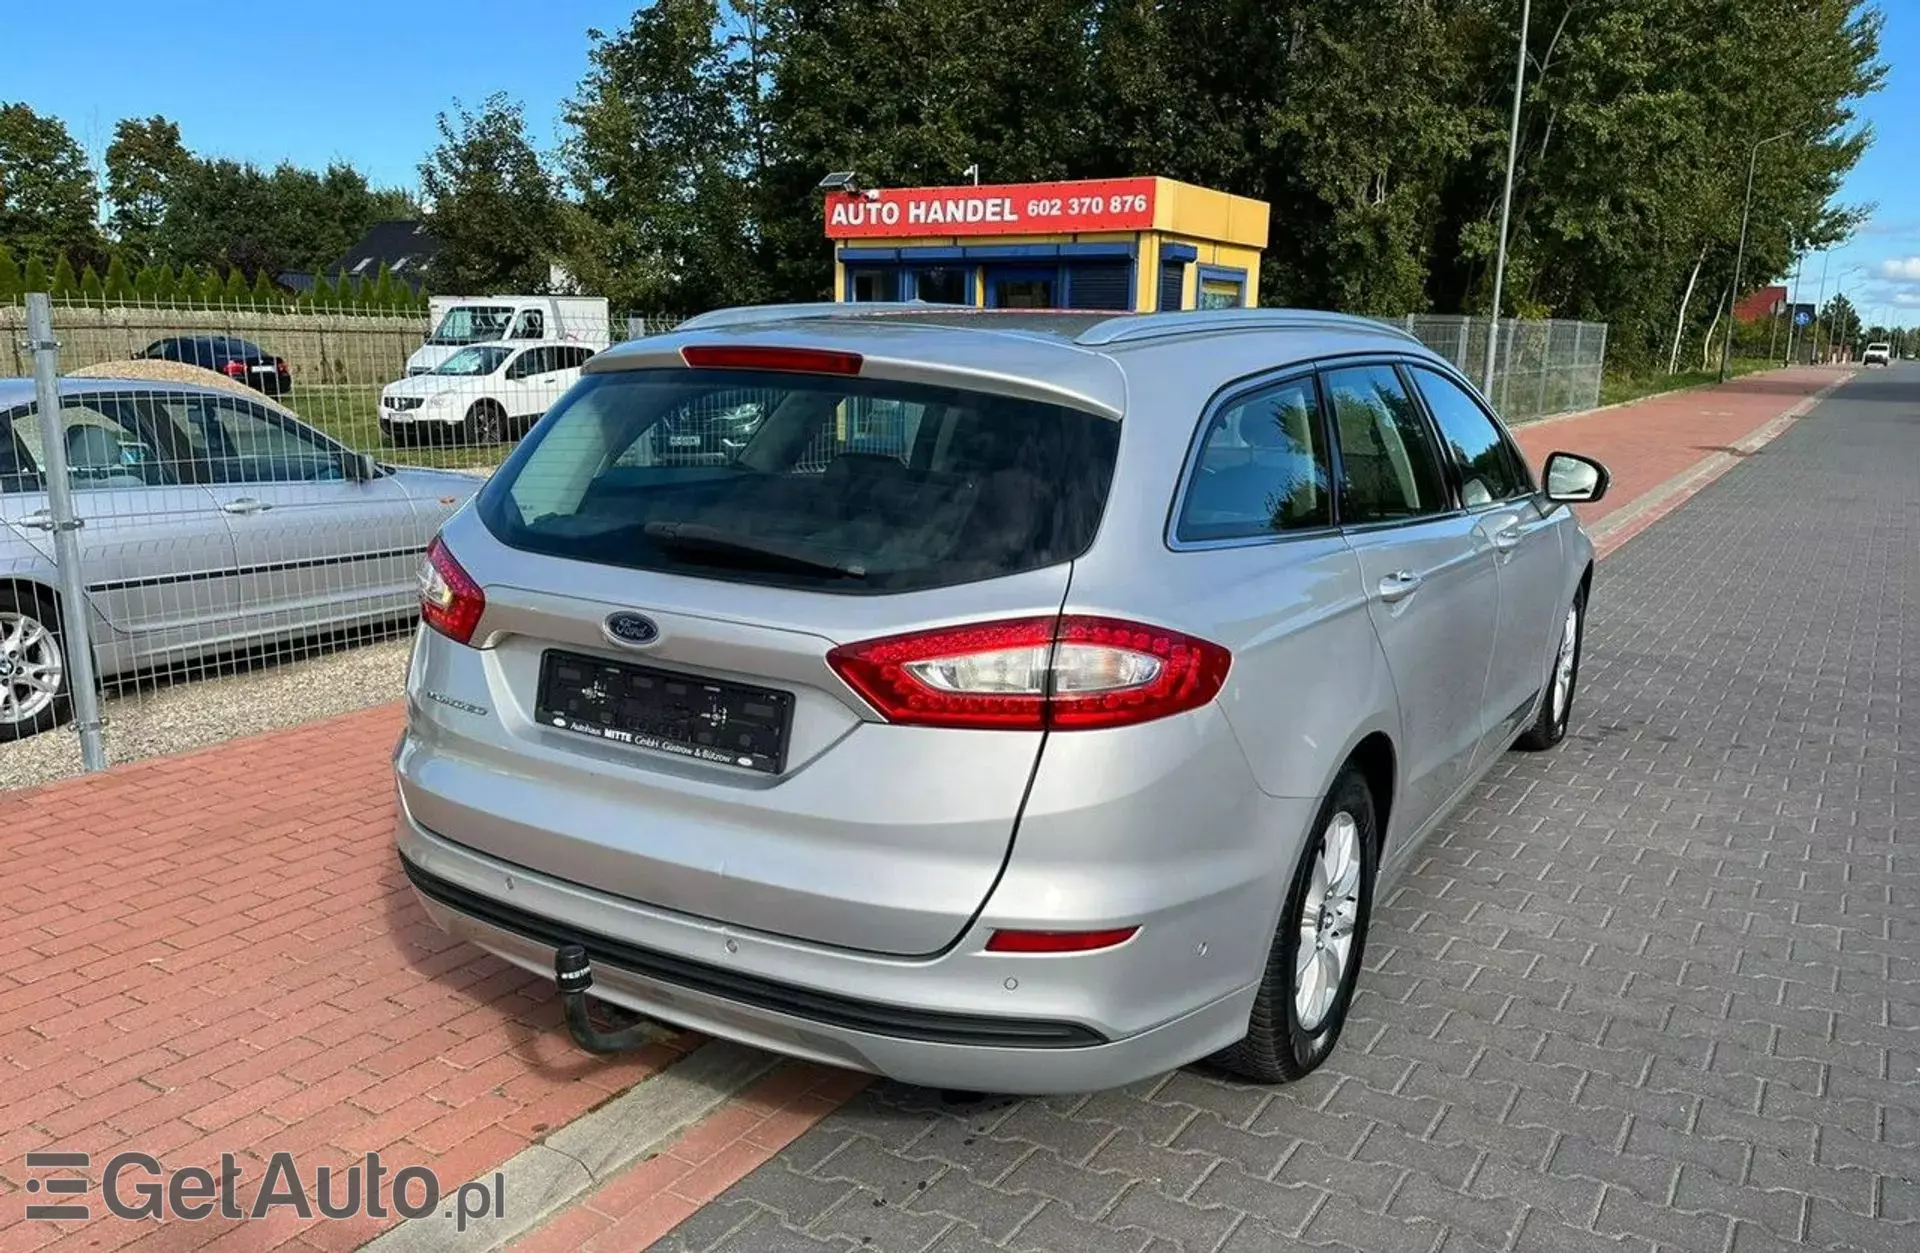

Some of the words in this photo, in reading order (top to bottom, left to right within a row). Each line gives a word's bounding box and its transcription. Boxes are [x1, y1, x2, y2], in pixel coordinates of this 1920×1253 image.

[831, 202, 900, 226] AUTO
[908, 197, 1018, 224] HANDEL
[1027, 198, 1062, 217] 602
[1067, 197, 1104, 215] 370
[1109, 194, 1147, 214] 876
[604, 727, 633, 743] MITTE
